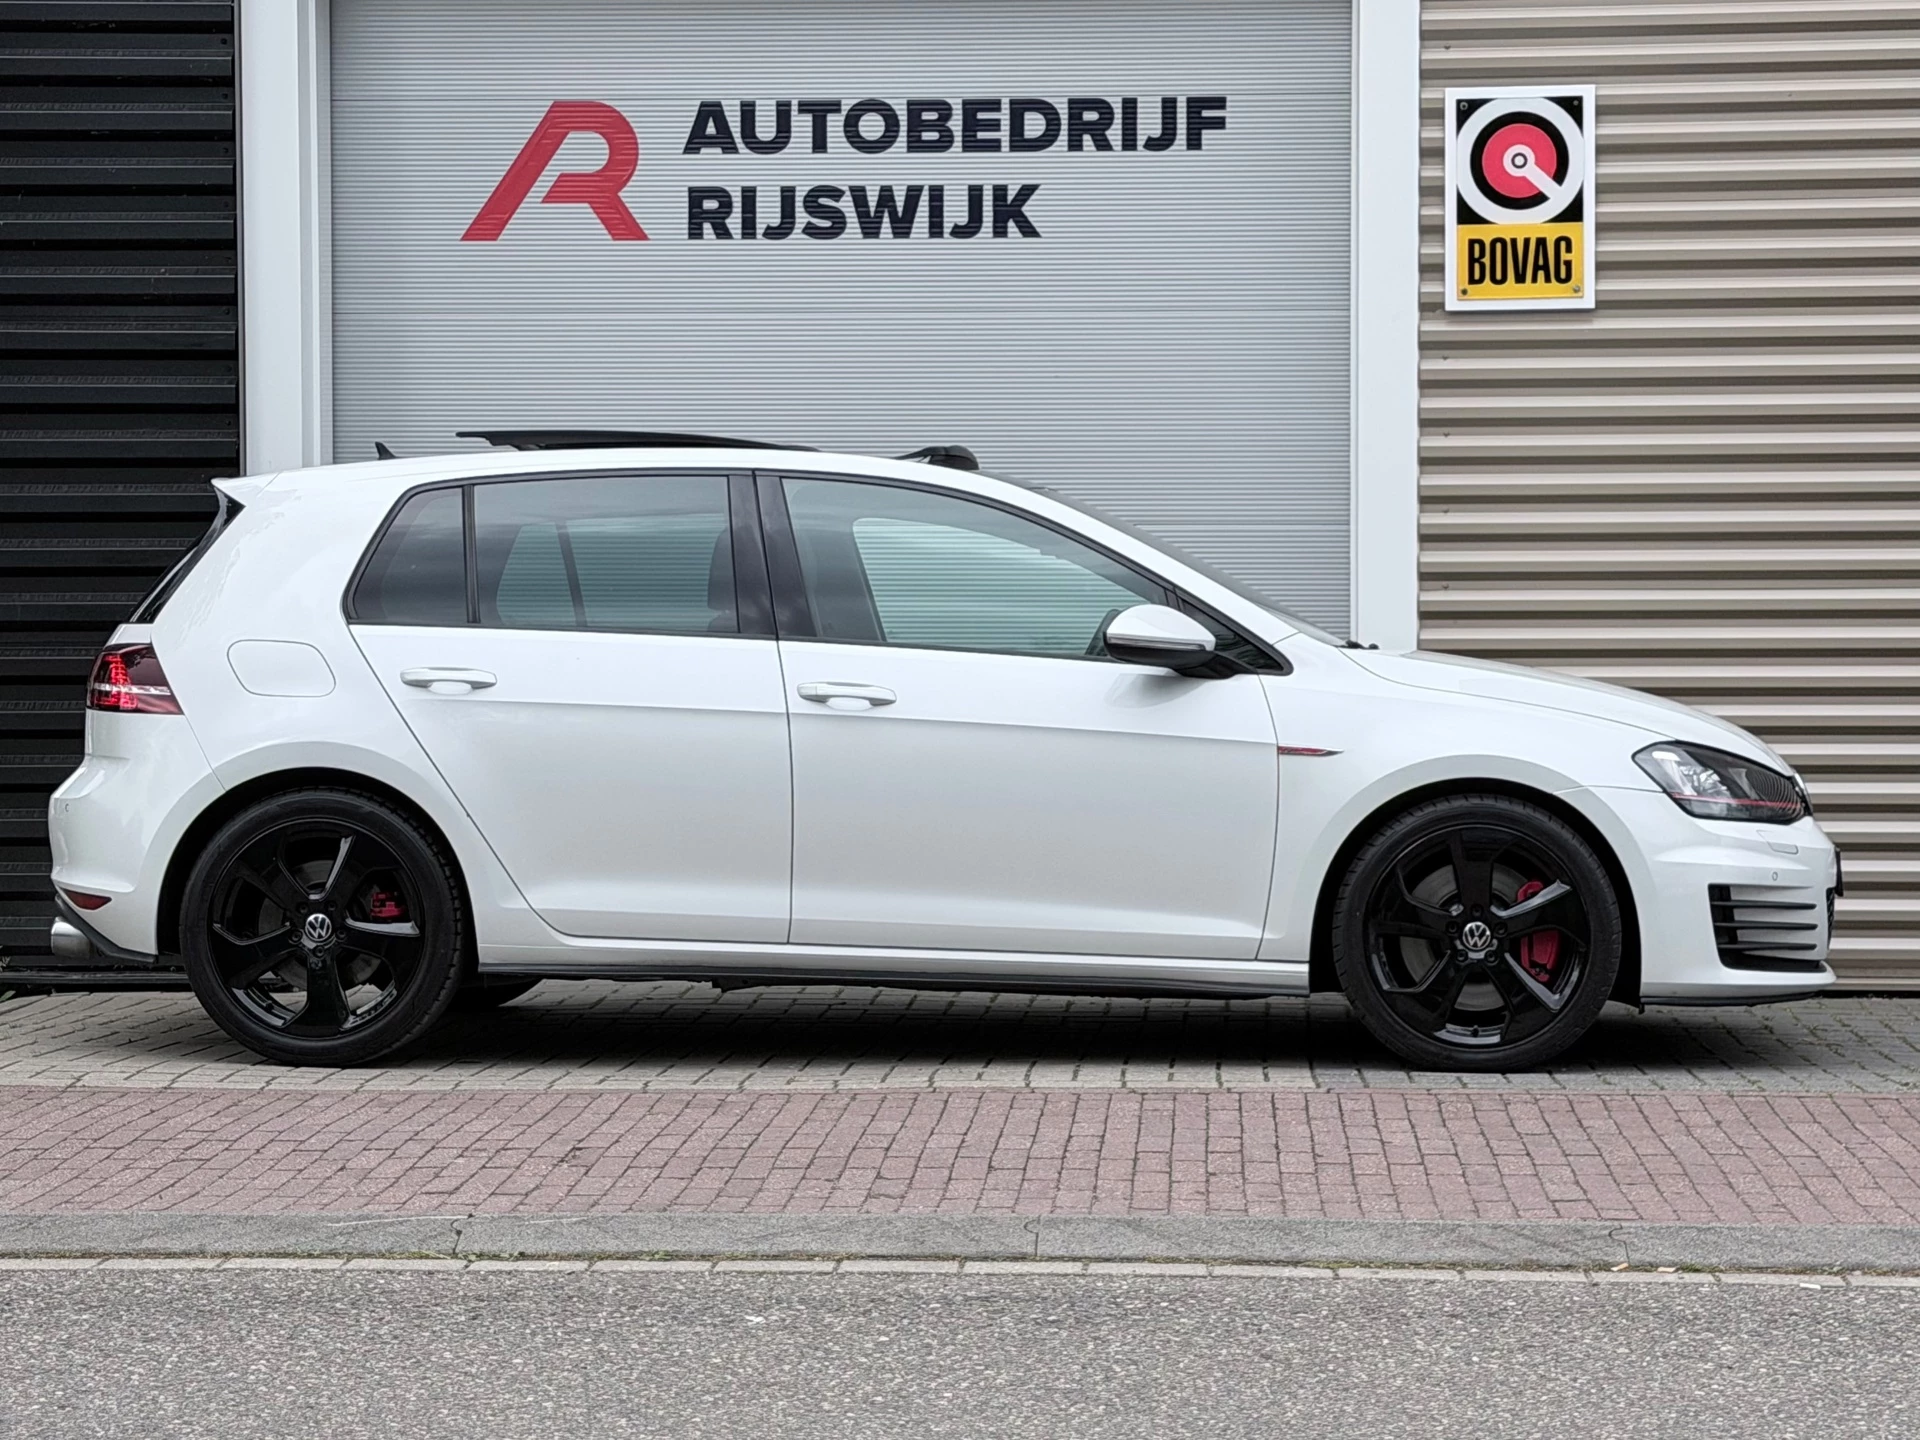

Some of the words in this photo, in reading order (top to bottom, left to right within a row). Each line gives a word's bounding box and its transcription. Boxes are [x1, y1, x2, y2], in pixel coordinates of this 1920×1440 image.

[682, 96, 1227, 155] AUTOBEDRIJF
[687, 184, 1041, 241] RIJSWIJK
[1467, 235, 1573, 286] BOVAG
[306, 914, 332, 942] VW
[1464, 922, 1491, 950] VW
